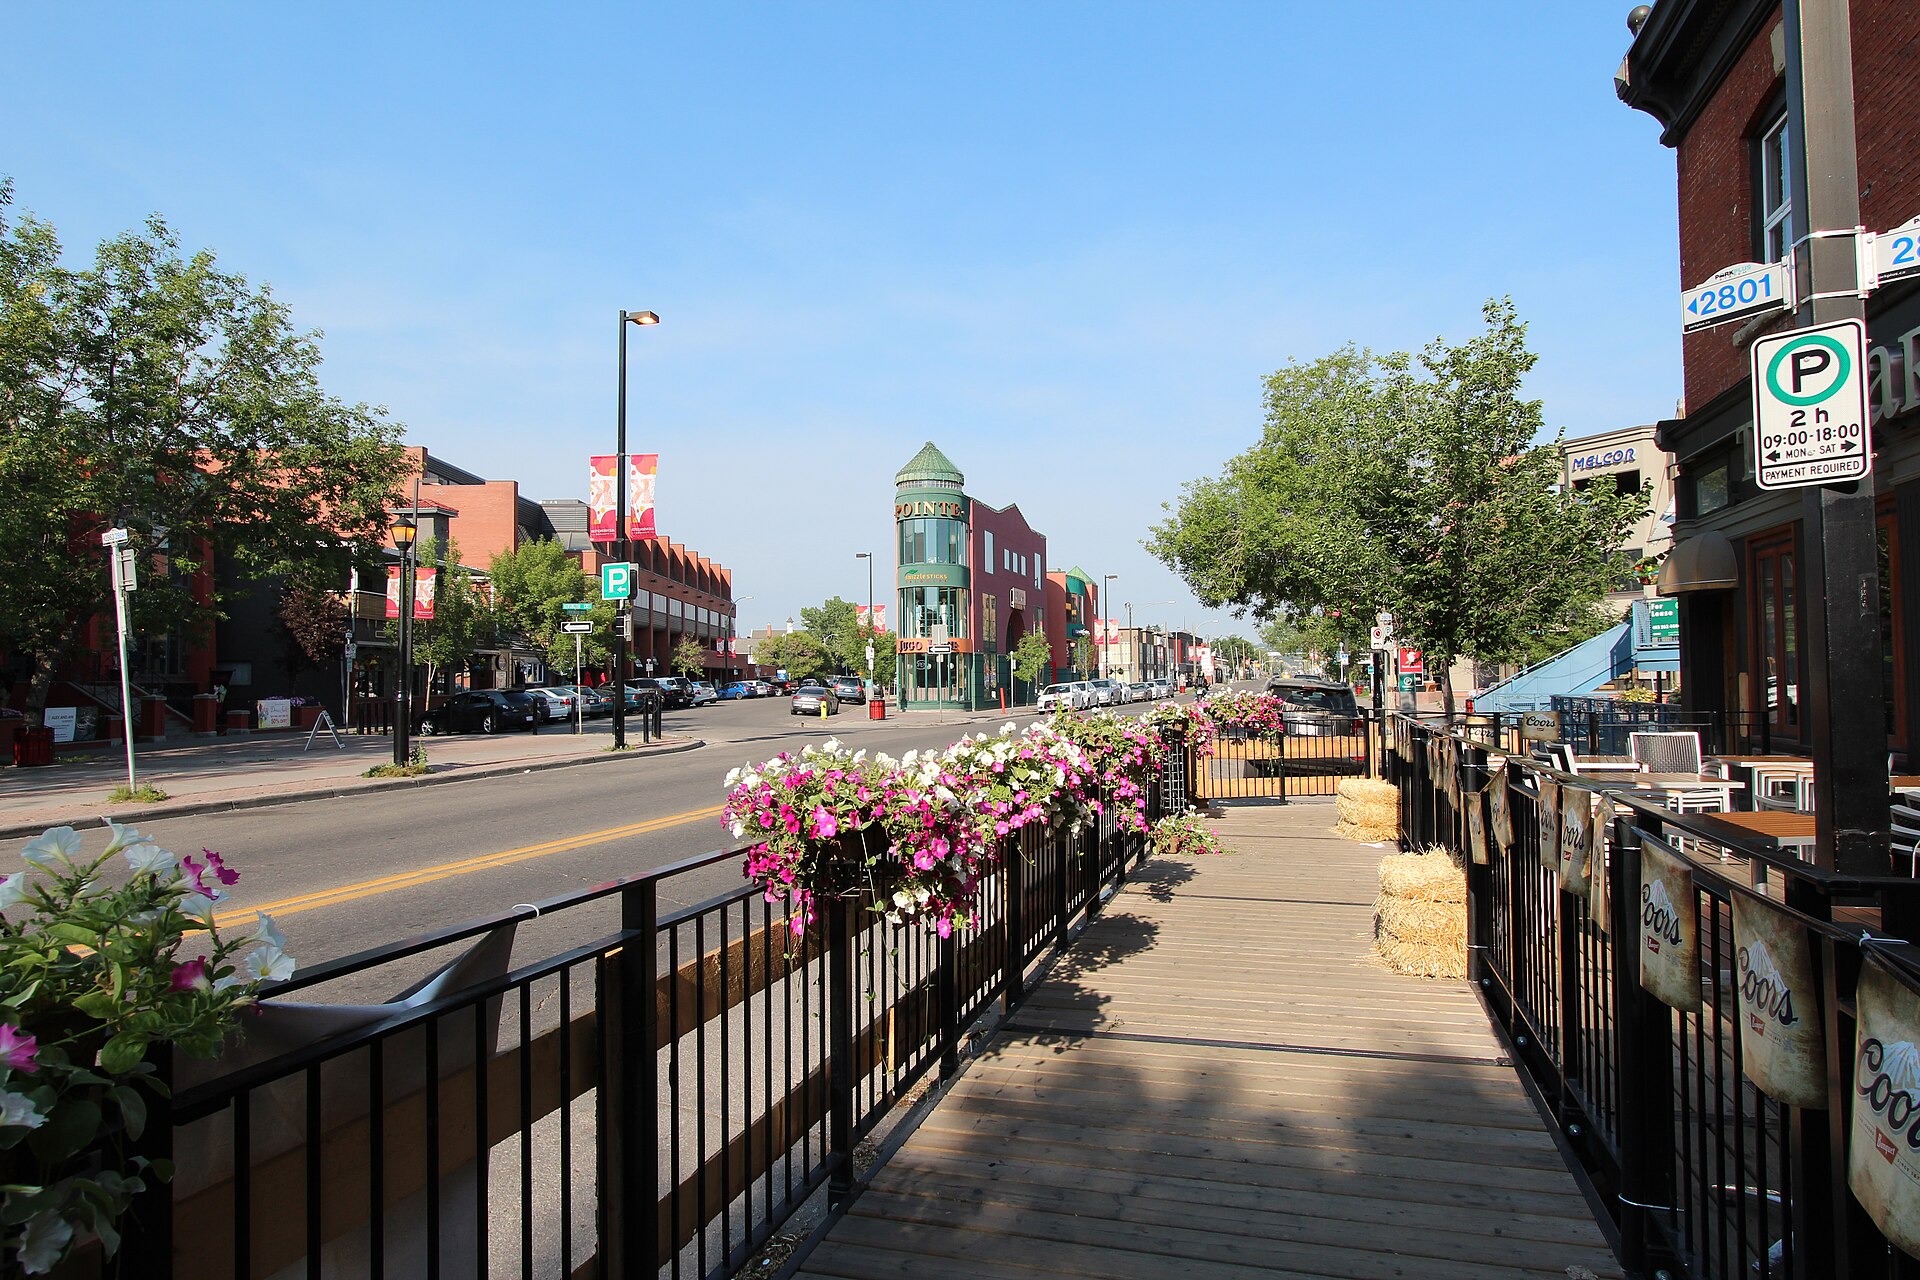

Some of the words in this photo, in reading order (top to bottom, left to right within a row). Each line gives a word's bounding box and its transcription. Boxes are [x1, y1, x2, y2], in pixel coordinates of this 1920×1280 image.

[1699, 273, 1771, 316] 2801
[1791, 348, 1831, 394] P
[1790, 409, 1806, 428] 2
[1815, 407, 1829, 424] h
[1763, 423, 1860, 449] 09:00-18:00
[1573, 447, 1636, 471] MELCOR
[1786, 448, 1806, 459] MON
[1819, 443, 1836, 455] SAT
[1765, 466, 1806, 481] PAYMENT
[1810, 460, 1860, 475] REQUIRED
[895, 501, 960, 518] POINTE
[608, 568, 627, 593] P
[1526, 715, 1557, 728] Coors
[1876, 1132, 1896, 1156] Banquet
